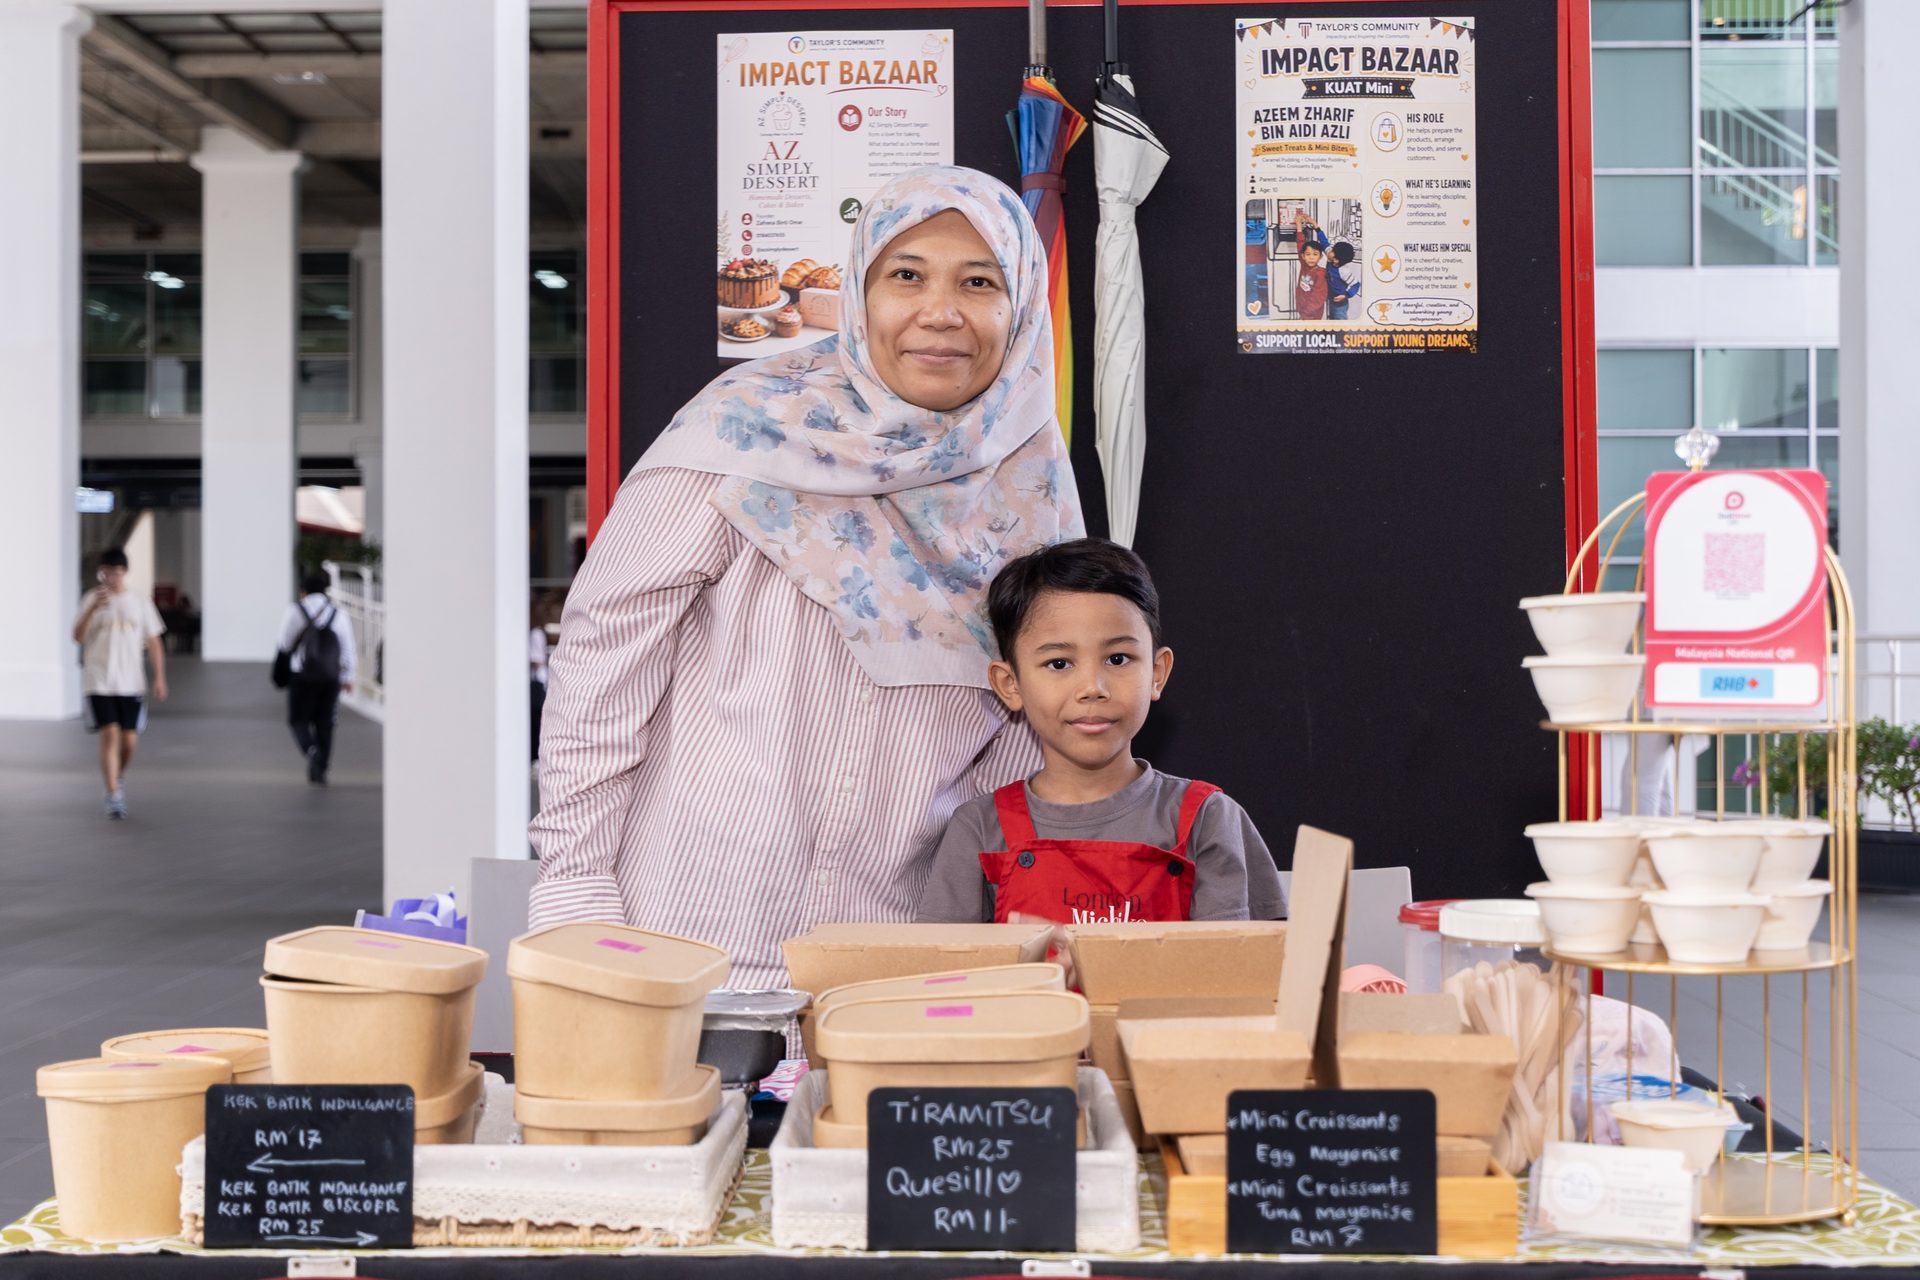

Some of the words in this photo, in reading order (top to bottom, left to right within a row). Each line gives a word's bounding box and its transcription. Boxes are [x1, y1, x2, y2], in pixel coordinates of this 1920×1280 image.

[1315, 23, 1359, 31] TAYLOR'S
[1361, 22, 1420, 31] COMMUNITY
[1262, 47, 1354, 75] IMPACT
[1361, 46, 1460, 75] BAZAAR
[739, 61, 831, 87] IMPACT
[839, 60, 939, 85] BAZAAR
[1325, 82, 1362, 94] KUAT
[1365, 81, 1393, 94] Mini
[760, 96, 784, 114] SIMPLY
[786, 96, 806, 127] DESSERT
[868, 106, 882, 117] Our
[884, 106, 908, 119] Story
[757, 117, 766, 127] AZ
[1254, 107, 1300, 124] AZEEM
[1304, 106, 1355, 122] ZHARIF
[1407, 113, 1421, 123] HIS
[1423, 113, 1445, 123] ROLE
[1261, 125, 1284, 140] BIN
[1289, 124, 1316, 138] AIDI
[1320, 124, 1350, 139] AZLI
[762, 140, 801, 161] AZ
[1262, 145, 1282, 153] Sweet
[746, 162, 813, 176] SIMPLY
[742, 175, 820, 190] DESSERT
[1405, 179, 1423, 189] WHAT
[1425, 179, 1439, 189] HE'S
[1440, 179, 1471, 189] LEARNING
[1403, 243, 1419, 252] WHAT
[1420, 243, 1438, 252] MAKES
[1440, 243, 1450, 252] HIM
[1451, 243, 1471, 252] SPECIAL
[1256, 334, 1304, 348] SUPPORT
[1306, 334, 1341, 347] LOCAL.
[1343, 334, 1390, 347] SUPPORT
[1392, 334, 1425, 347] YOUNG
[1427, 334, 1471, 347] DREAMS.
[1675, 648, 1724, 660] Malaysia
[1725, 647, 1774, 658] National
[1775, 647, 1795, 660] QR
[1712, 676, 1745, 692] RHB
[224, 1094, 257, 1110] KEK
[267, 1095, 312, 1111] BATIK
[320, 1094, 414, 1112] INDULGANCE
[1240, 1109, 1288, 1131] Mini
[1295, 1109, 1401, 1132] Croissants
[255, 1130, 288, 1147] RM
[299, 1129, 323, 1149] 17
[1256, 1142, 1296, 1168] Egg
[221, 1179, 257, 1196] KEK
[267, 1180, 310, 1196] BATIK
[1241, 1178, 1285, 1199] Mini
[1297, 1174, 1410, 1197] Croissants
[265, 1199, 311, 1215] BATIK
[1257, 1201, 1302, 1222] Tuna
[259, 1217, 290, 1235] RM
[297, 1219, 325, 1235] 25
[1291, 1226, 1335, 1247] RM
[1339, 1224, 1364, 1247] 7
